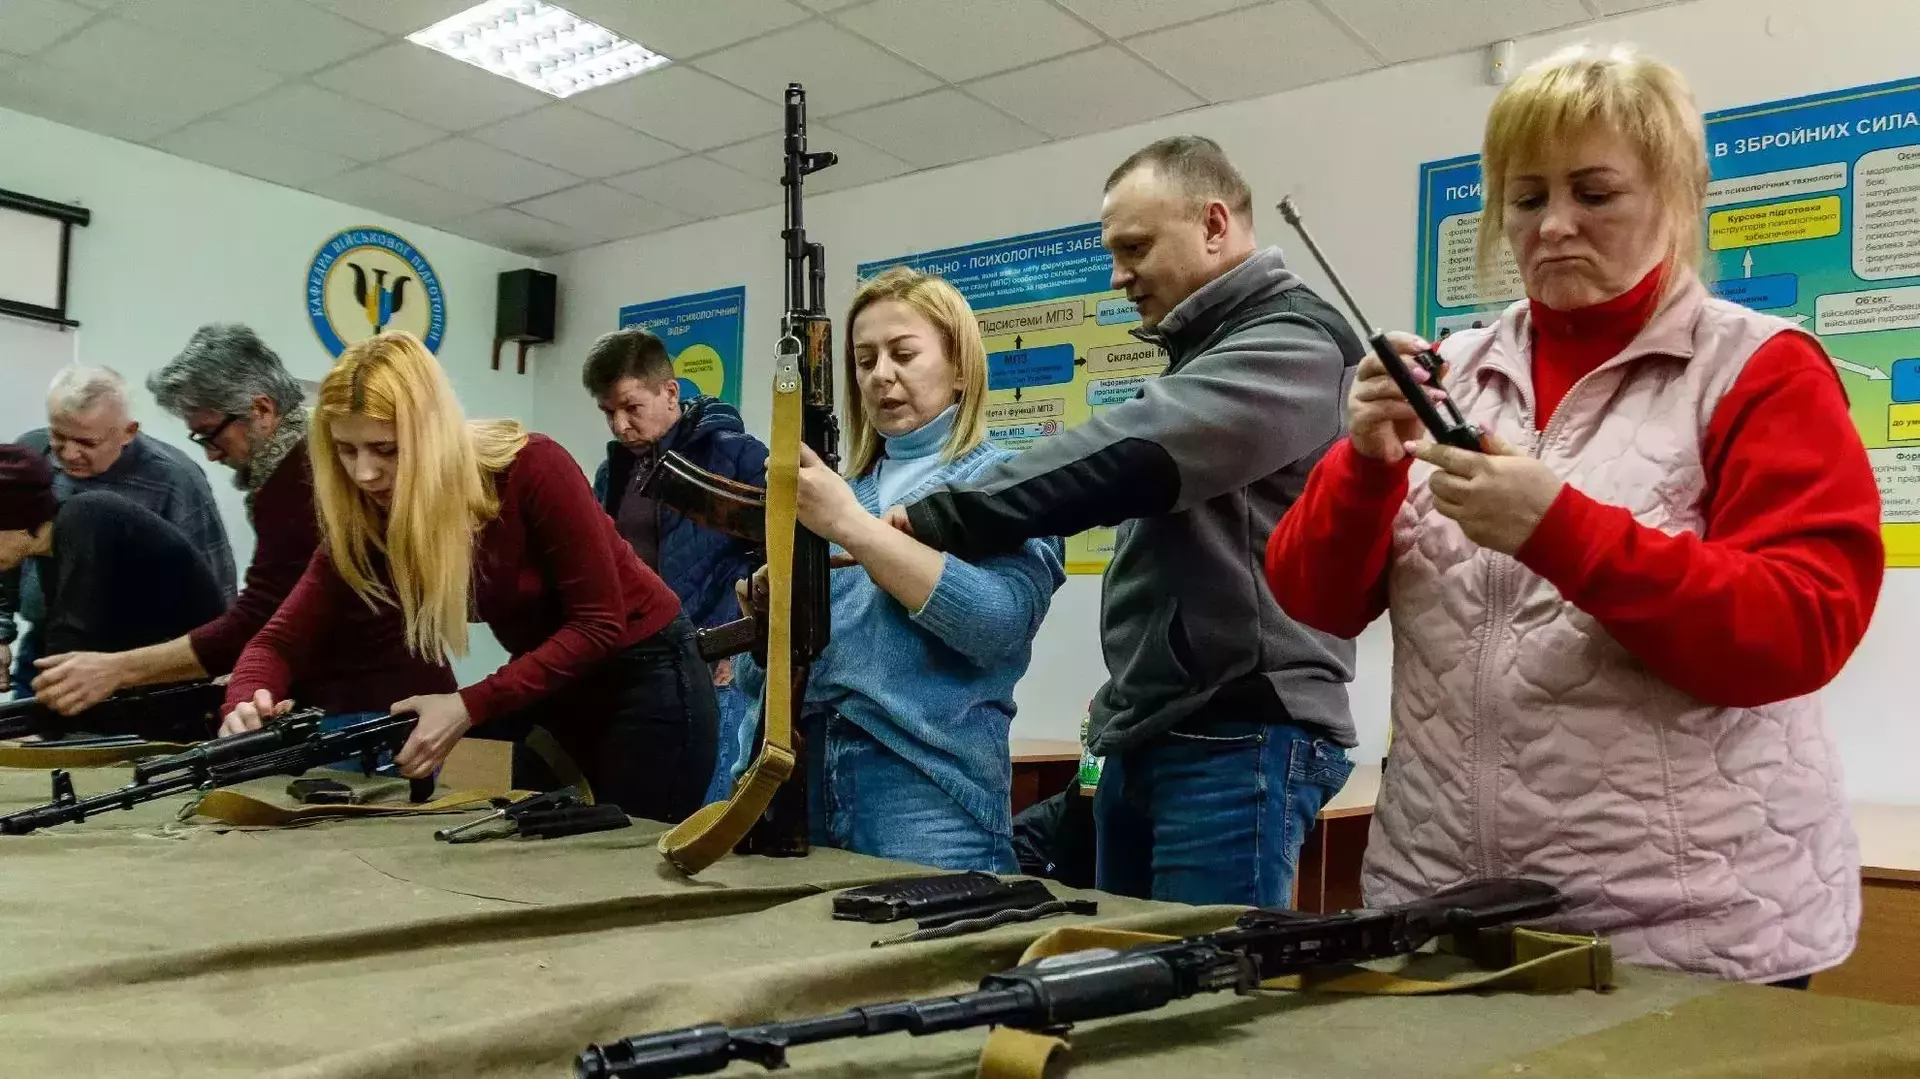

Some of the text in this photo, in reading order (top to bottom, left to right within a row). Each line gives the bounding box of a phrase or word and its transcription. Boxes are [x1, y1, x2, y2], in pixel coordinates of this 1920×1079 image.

[1714, 111, 1920, 157] В ЗБРОЙНИХ СИЛА
[1446, 183, 1482, 201] ПСИ
[1727, 204, 1821, 223] Курсова підготовка
[331, 231, 411, 255] ВІЙСЬКОВОЇ
[969, 242, 1064, 270] ПСИХОЛОГІЧНЕ
[1066, 235, 1101, 253] ЗАБЕ
[309, 252, 333, 317] КАФЕДРА
[411, 255, 443, 341] ПІДГОТОВКИ
[676, 305, 739, 323] ПСИХОЛОГІЧНИЙ
[977, 308, 1074, 333] Підсистеми МПЗ
[1107, 348, 1155, 363] Складові
[1008, 406, 1036, 417] функції
[1037, 403, 1054, 412] МПЗ
[989, 427, 1025, 438] Мета МПЗ
